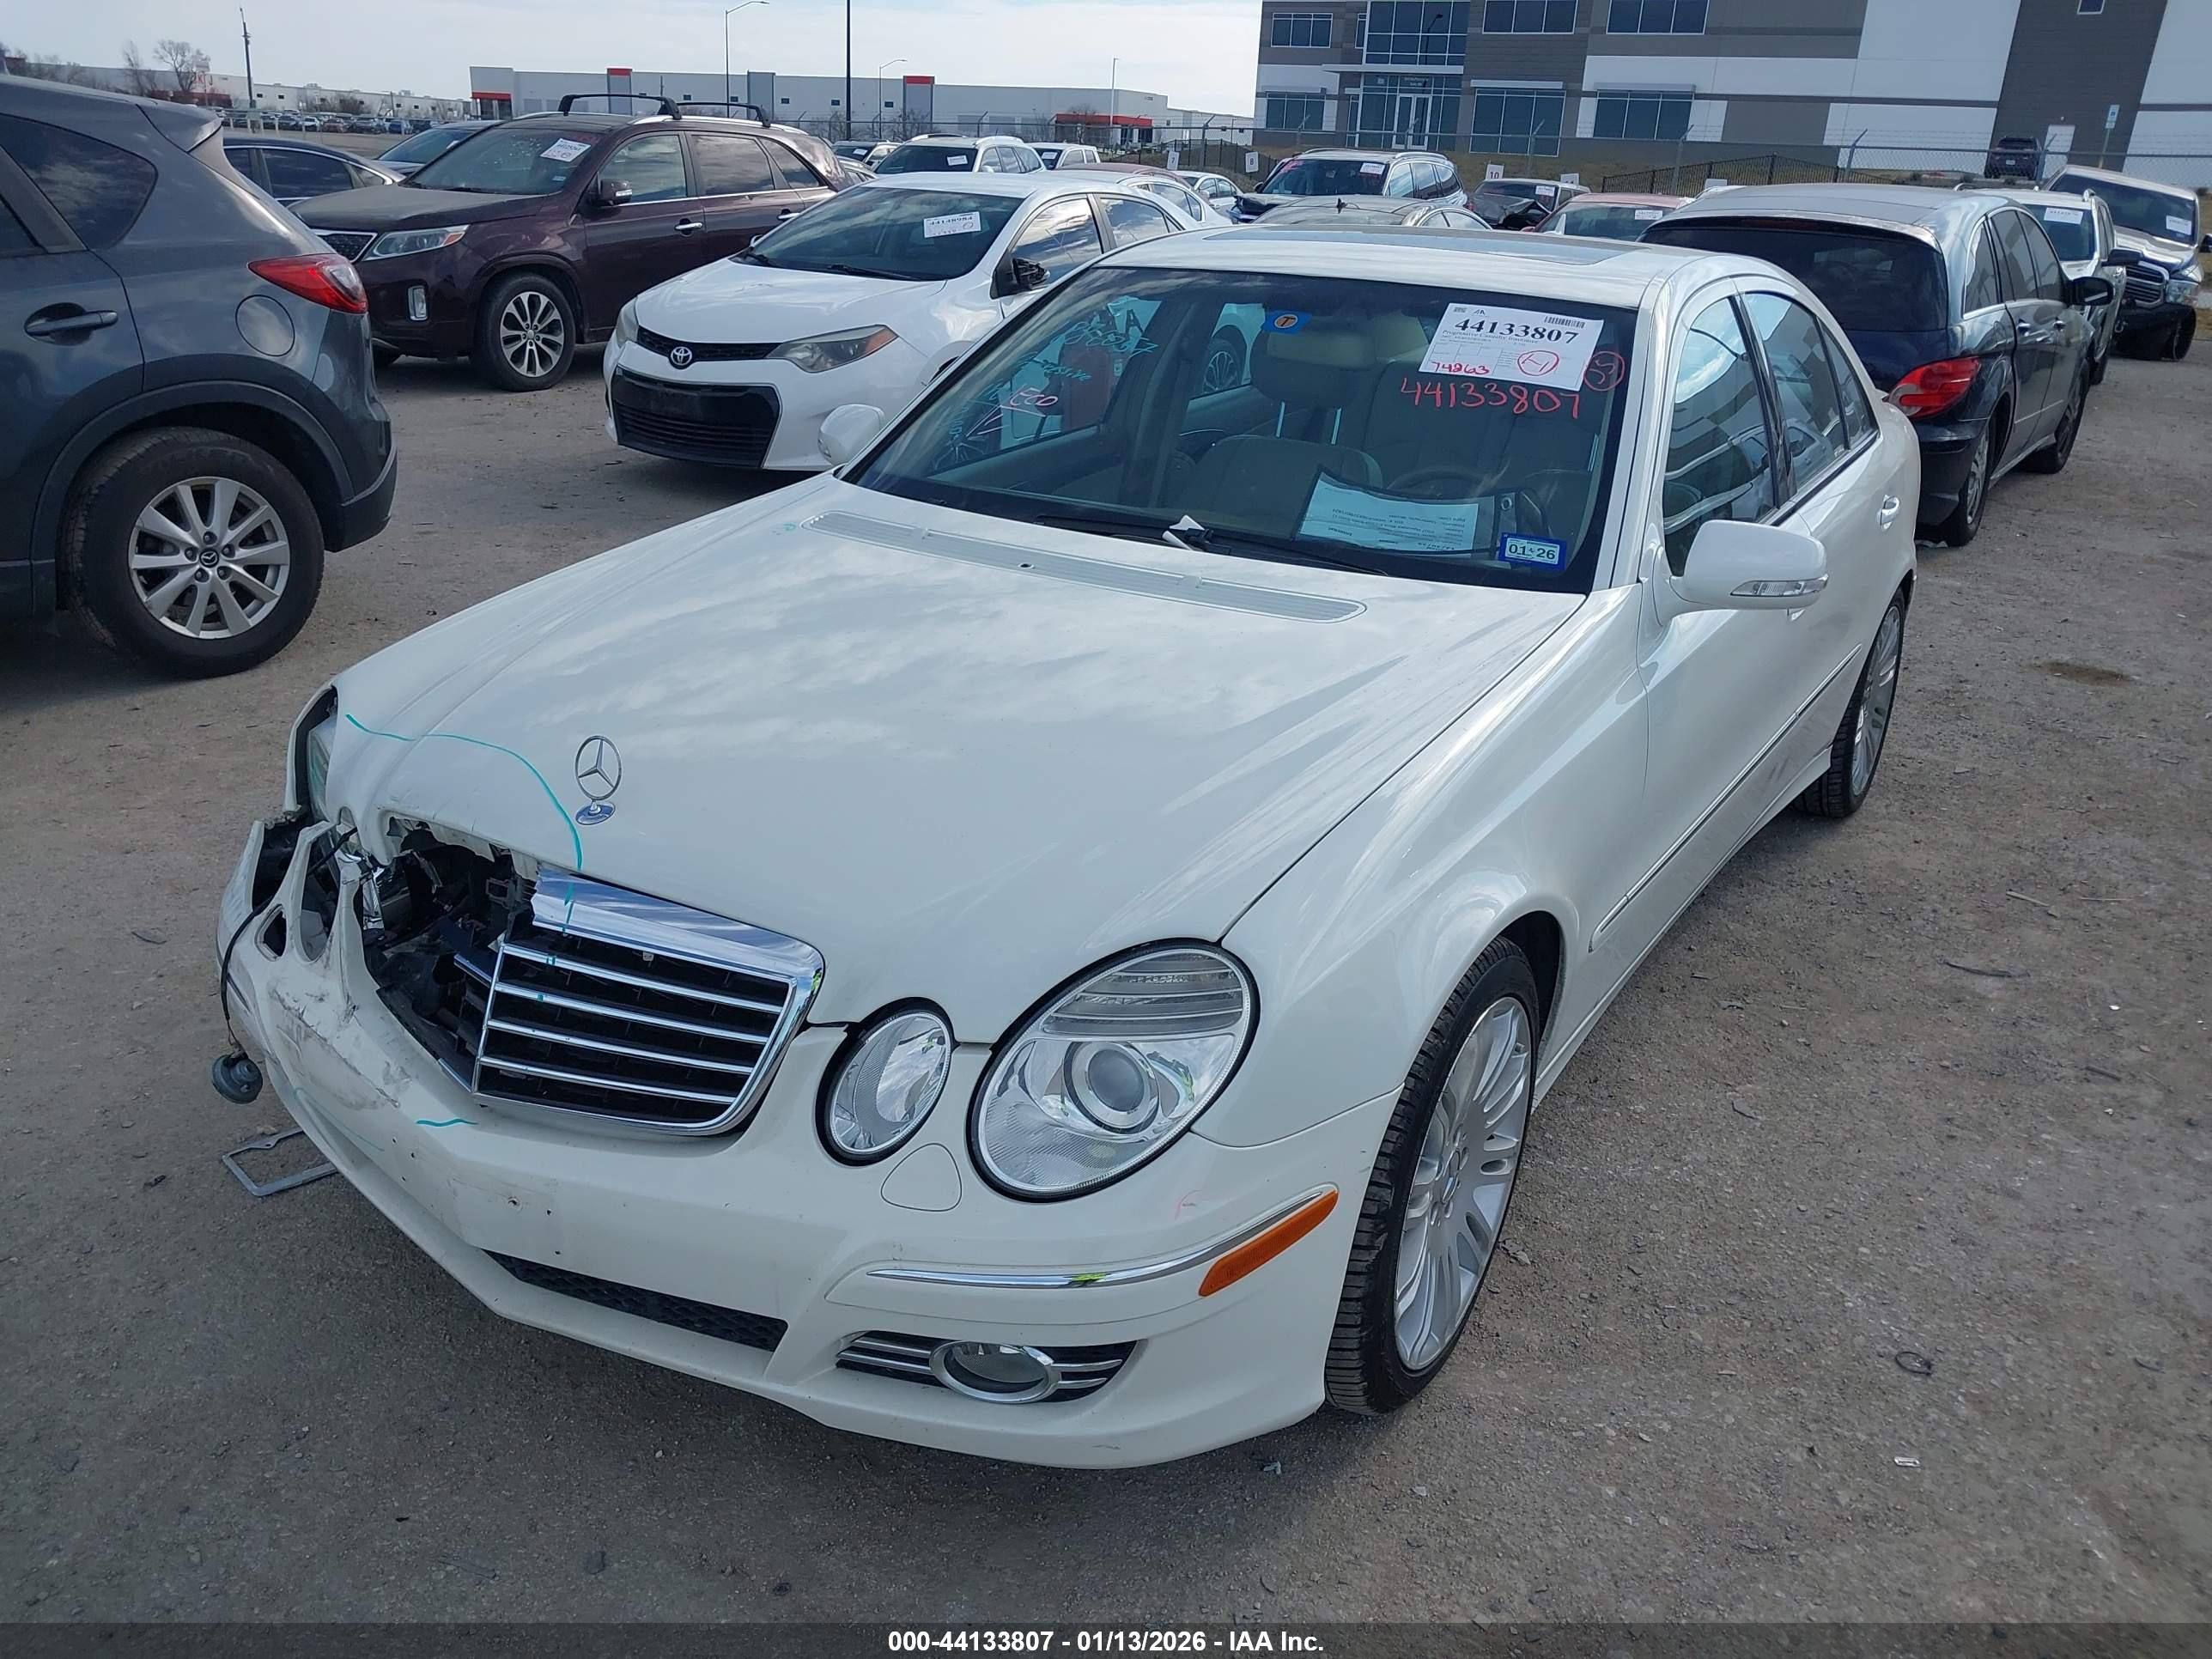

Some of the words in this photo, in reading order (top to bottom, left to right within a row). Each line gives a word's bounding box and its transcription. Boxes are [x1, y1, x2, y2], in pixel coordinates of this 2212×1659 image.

[1455, 318, 1579, 343] 44133807
[1401, 378, 1580, 419] 44133807
[1509, 544, 1526, 556] 01
[1536, 548, 1556, 560] 26
